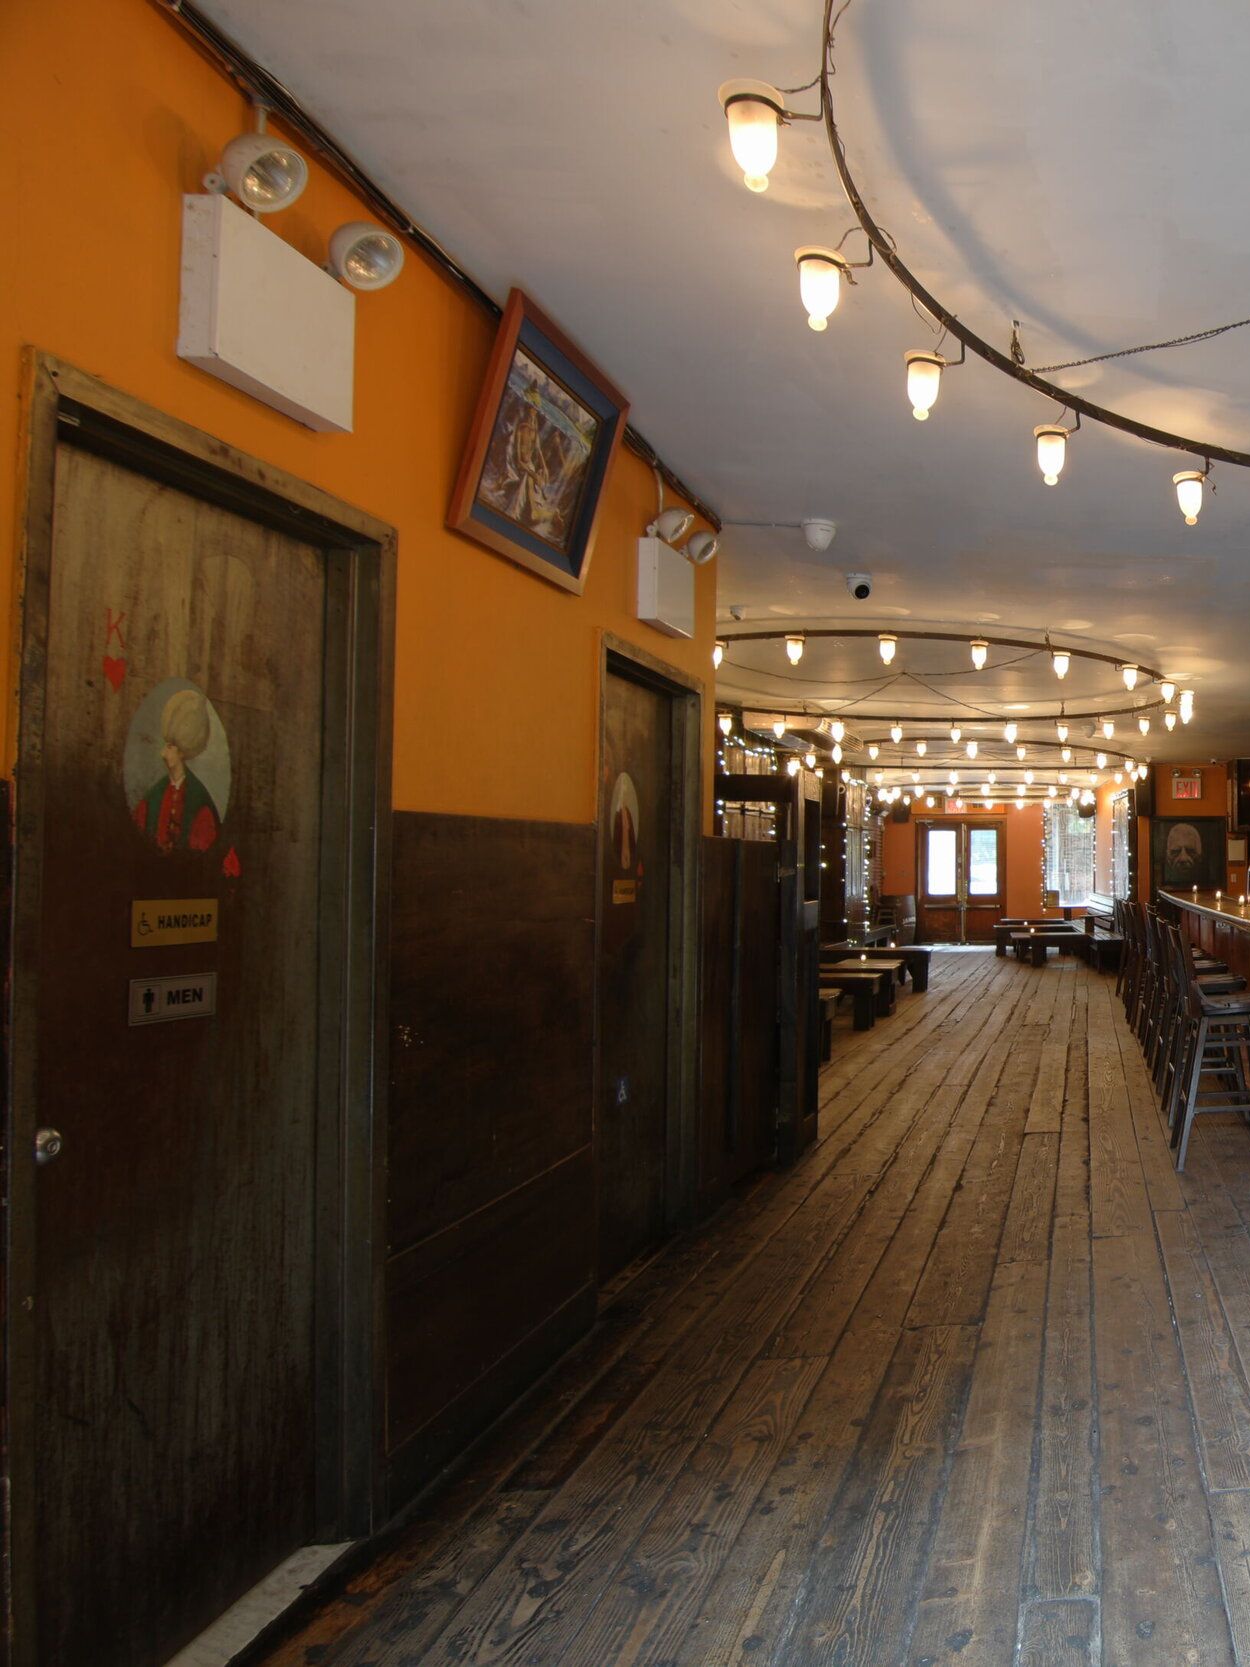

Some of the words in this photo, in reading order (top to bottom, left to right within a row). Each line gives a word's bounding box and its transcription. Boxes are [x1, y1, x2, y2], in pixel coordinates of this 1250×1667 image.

[104, 607, 127, 650] K
[1175, 781, 1199, 799] EXIT
[157, 913, 213, 929] HANDICAP
[166, 987, 203, 1005] MEN
